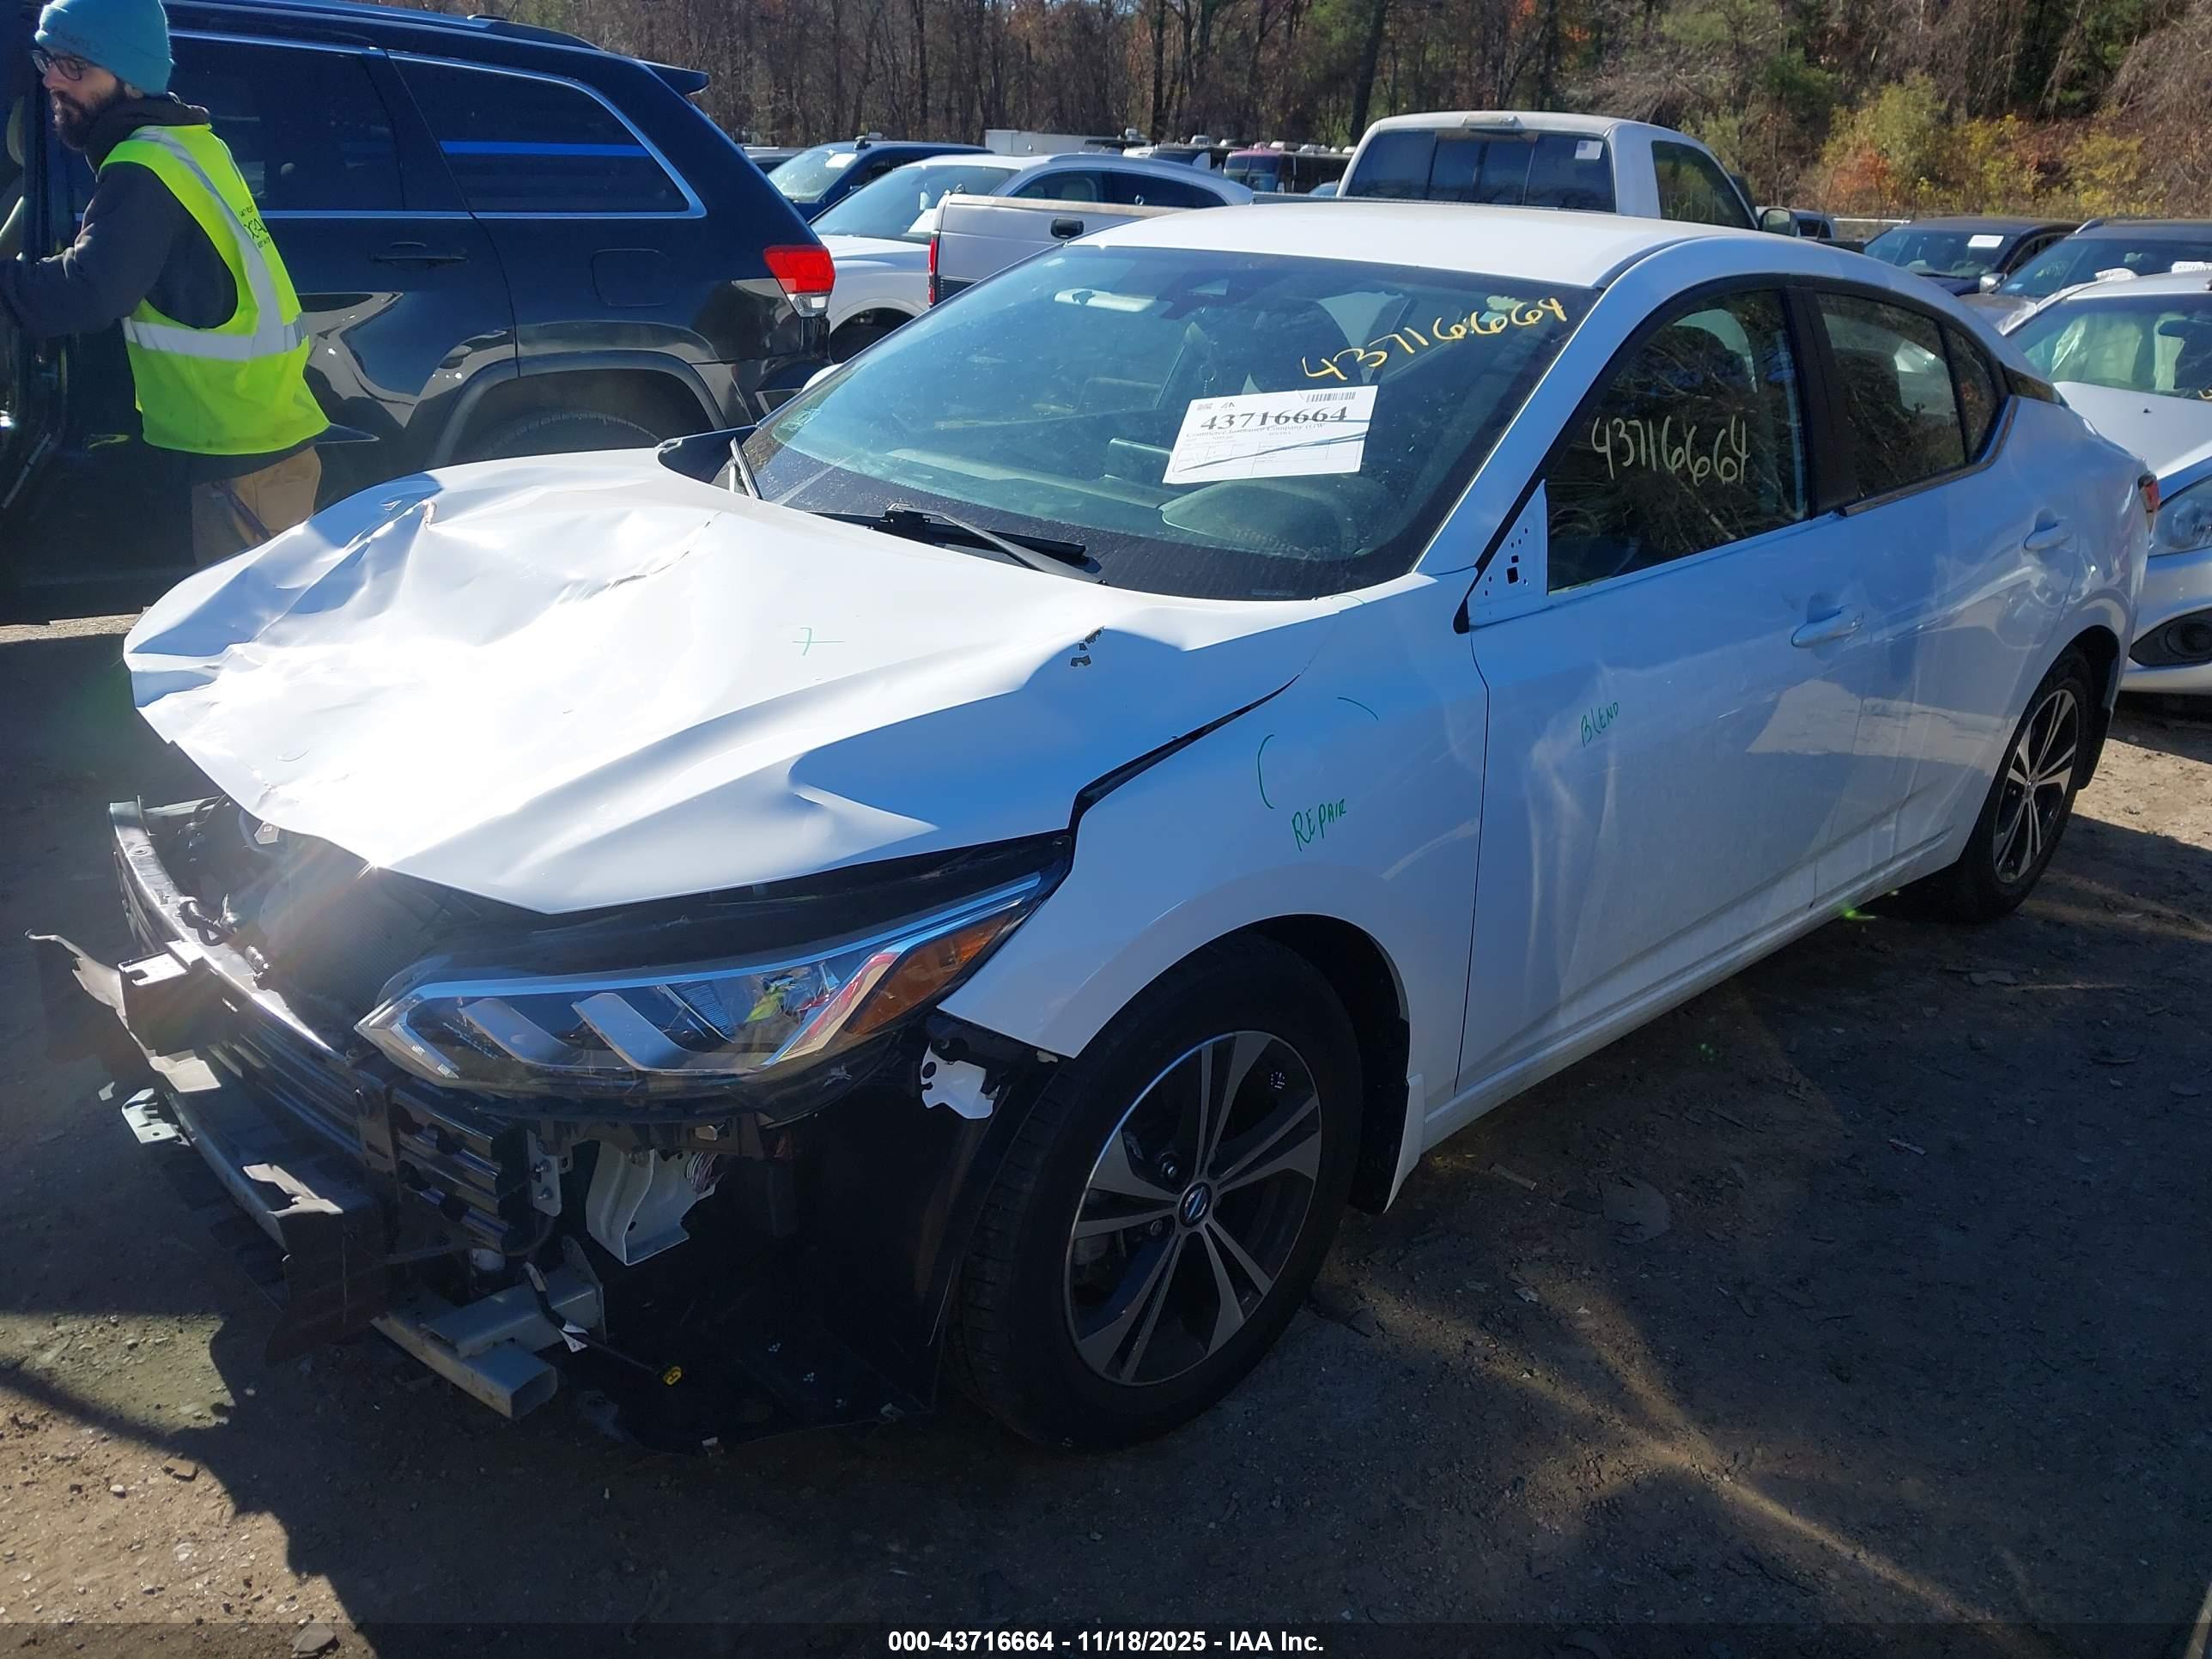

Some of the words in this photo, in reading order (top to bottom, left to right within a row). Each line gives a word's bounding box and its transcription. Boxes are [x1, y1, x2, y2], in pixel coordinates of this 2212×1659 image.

[1303, 297, 1568, 380] 43716664
[1200, 406, 1347, 430] 43716664
[1590, 415, 1752, 487] 43716664
[1580, 701, 1620, 747] BLEND
[1291, 798, 1347, 852] REPAIR
